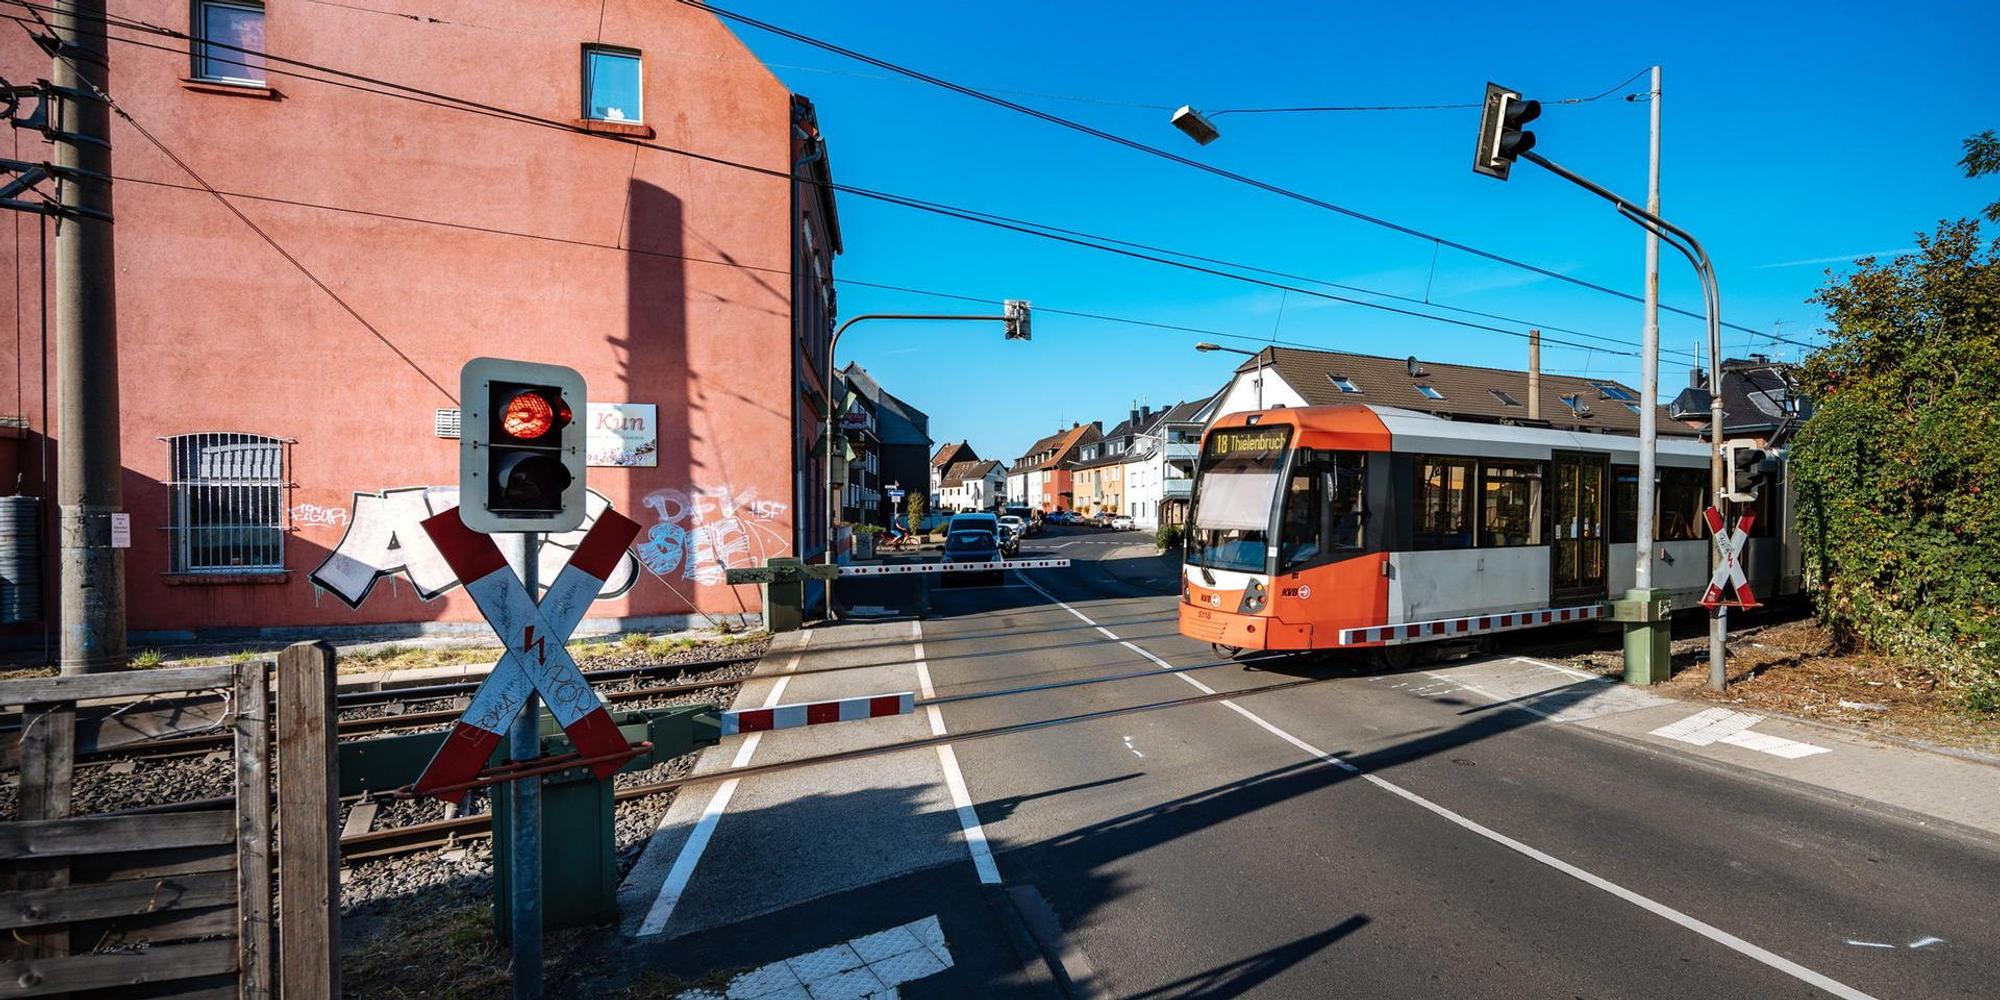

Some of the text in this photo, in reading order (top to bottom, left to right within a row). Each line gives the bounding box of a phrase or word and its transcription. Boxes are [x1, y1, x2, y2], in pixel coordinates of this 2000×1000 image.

[595, 412, 645, 431] Kun
[1216, 432, 1287, 454] 18 Thielenbruch
[1281, 587, 1299, 597] KVB
